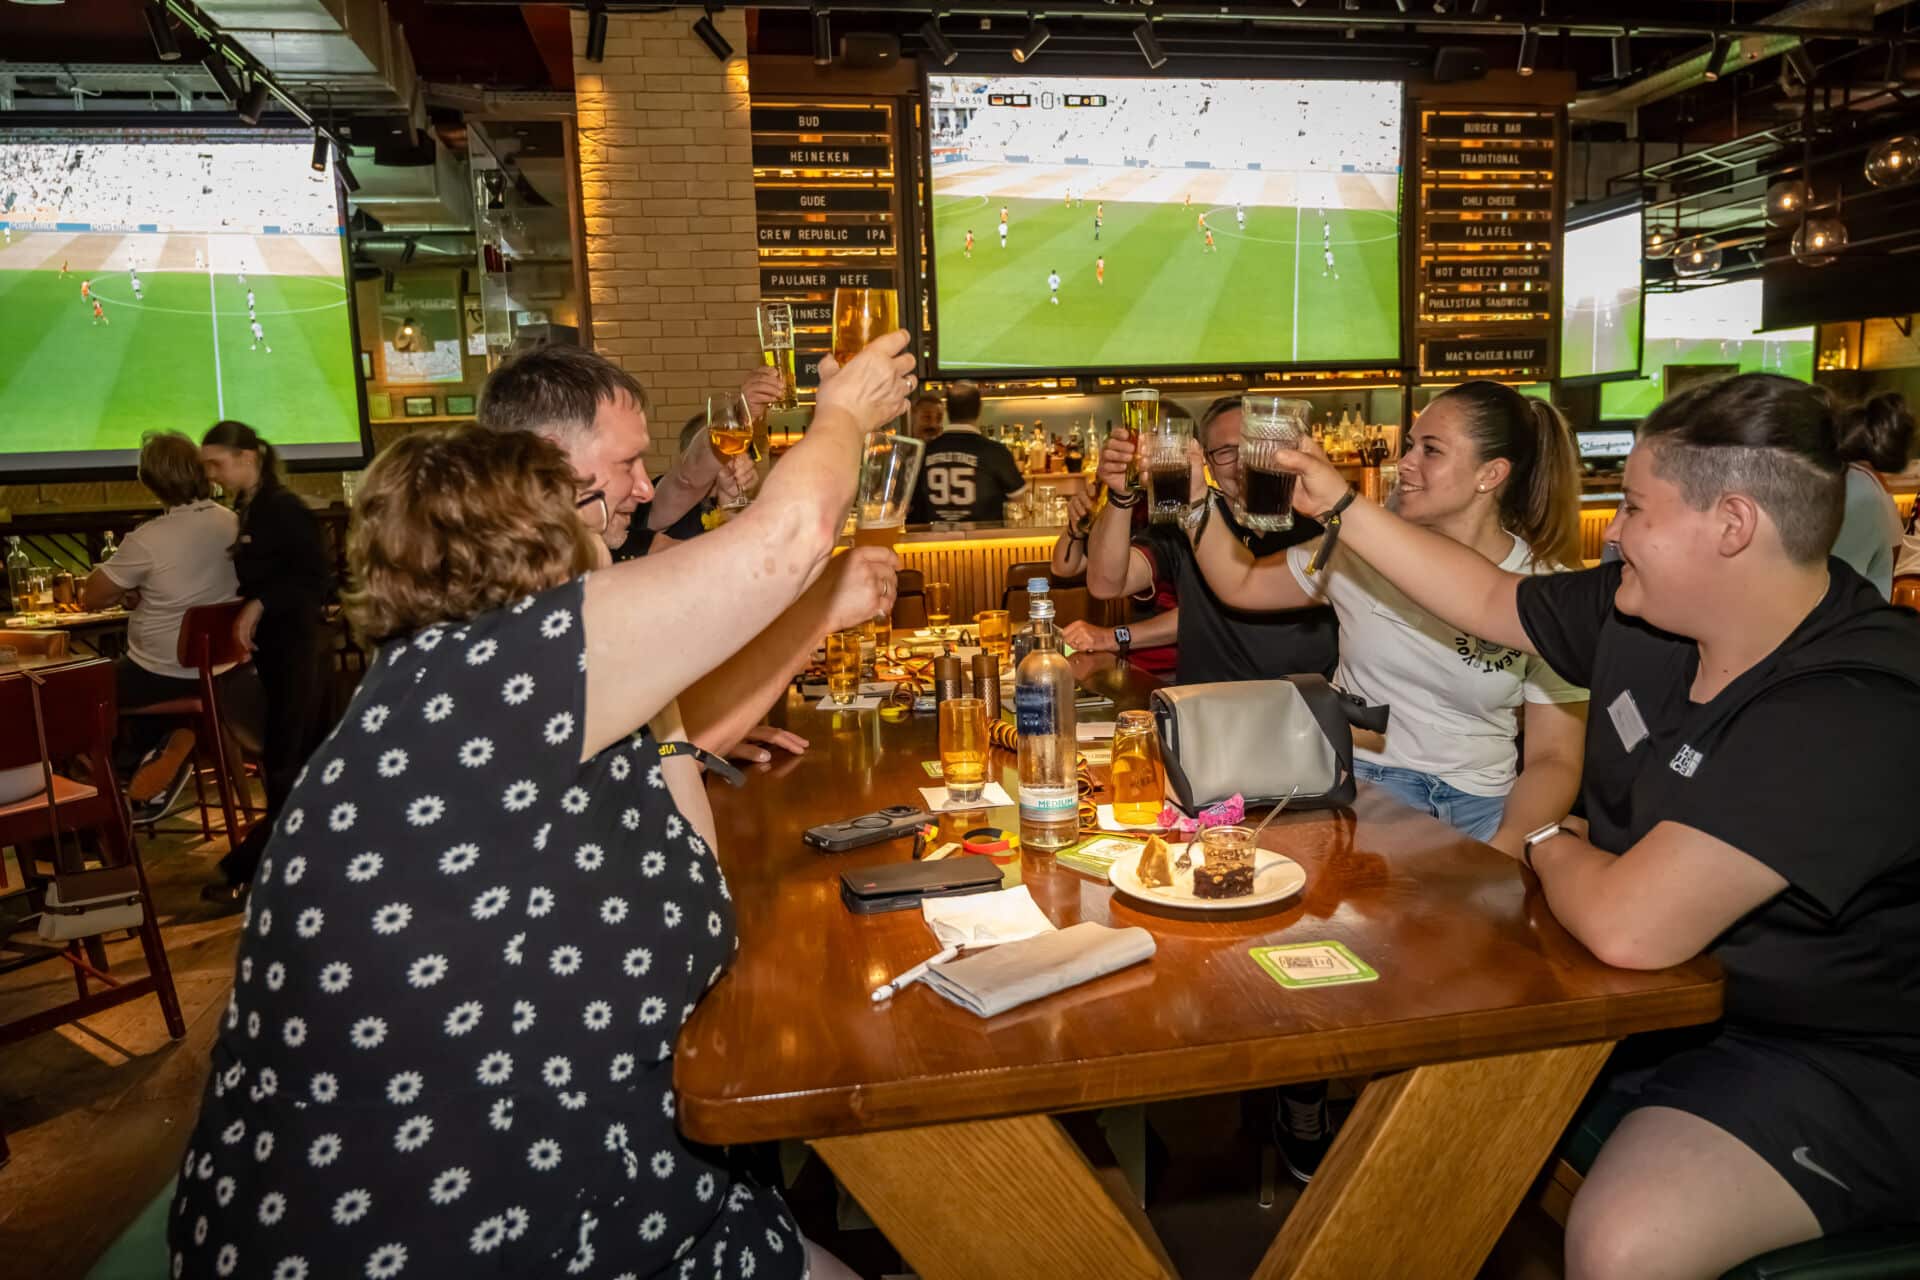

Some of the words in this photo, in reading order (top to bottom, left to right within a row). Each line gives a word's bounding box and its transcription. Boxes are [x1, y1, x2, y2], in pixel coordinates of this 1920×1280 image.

[799, 116, 820, 127] BUD
[1464, 123, 1499, 133] BURGER
[1505, 123, 1522, 133] BAR
[790, 151, 849, 162] HEINEKEN
[1460, 153, 1520, 164] TRADITIONAL
[800, 195, 826, 207] GUDE
[1487, 196, 1517, 206] CHEESE
[760, 229, 791, 240] CREW
[798, 229, 849, 240] REPUBLIC
[867, 229, 886, 240] IPA
[1466, 226, 1513, 237] FALAFEL
[1435, 267, 1453, 277] HOT
[1503, 266, 1540, 277] CHICKEN
[771, 275, 826, 286] PAULANER
[840, 274, 869, 285] HEFE
[791, 308, 831, 319] INNESS
[927, 467, 977, 505] 95
[1455, 634, 1476, 666] YOU
[658, 743, 678, 756] VIP
[1038, 798, 1073, 808] MEDIUM
